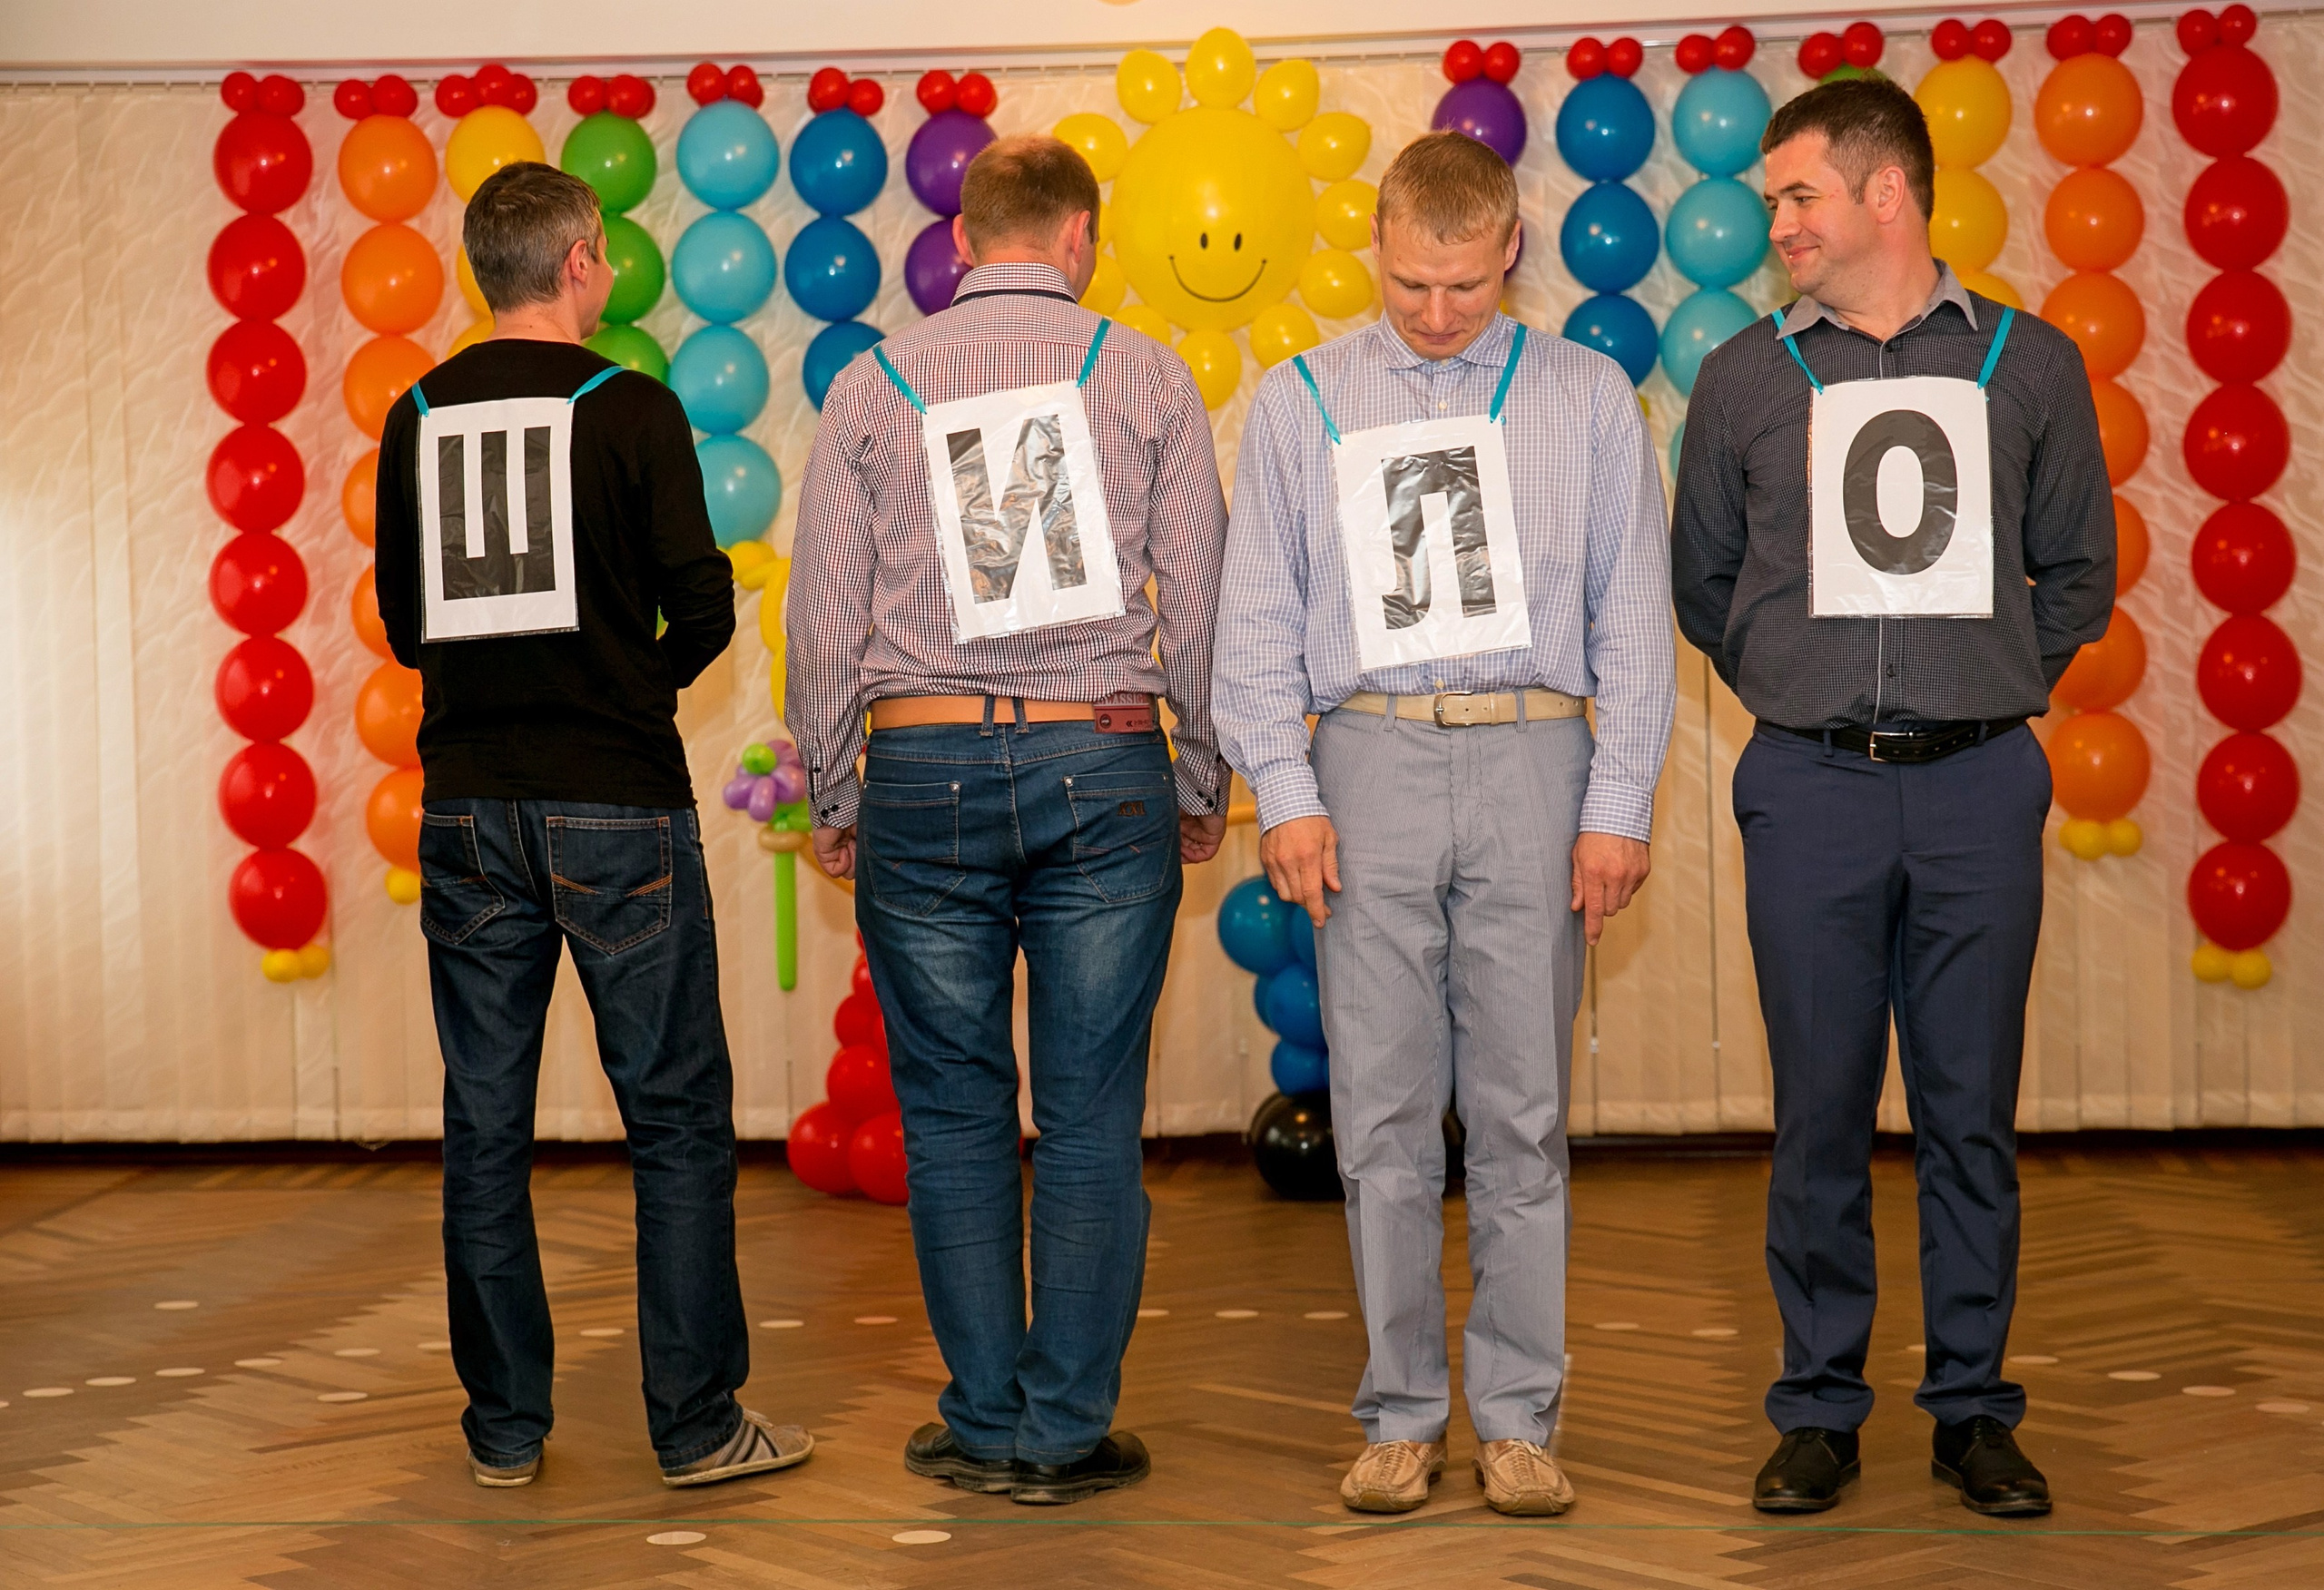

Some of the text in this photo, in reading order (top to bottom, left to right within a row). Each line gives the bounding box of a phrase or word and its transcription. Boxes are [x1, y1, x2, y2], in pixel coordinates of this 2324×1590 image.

[438, 427, 556, 601] Ш
[946, 414, 1088, 604] И
[1382, 446, 1496, 630] Л
